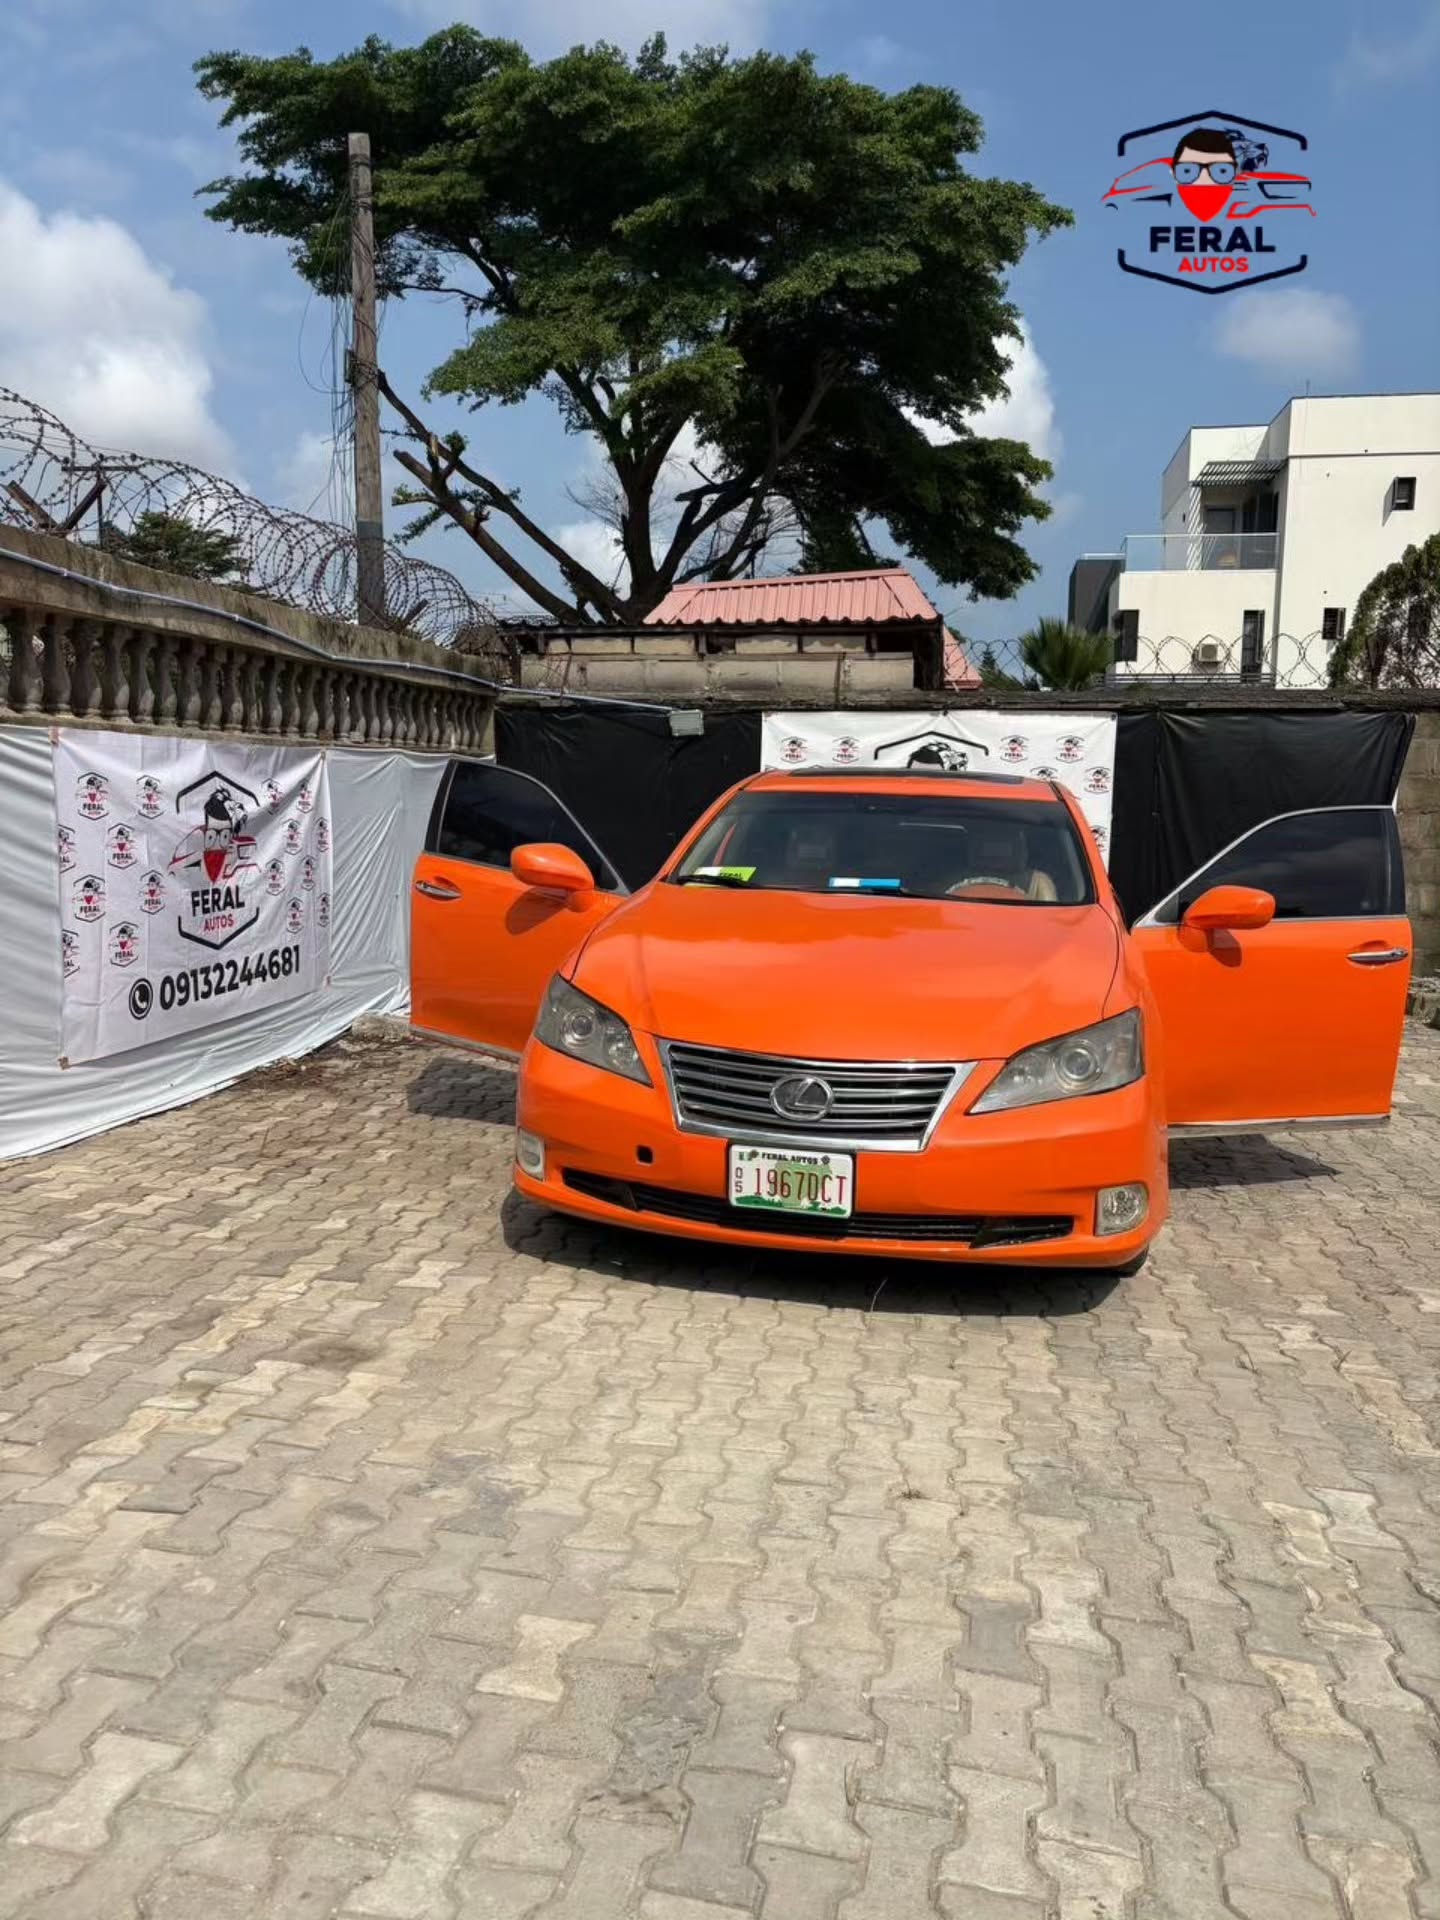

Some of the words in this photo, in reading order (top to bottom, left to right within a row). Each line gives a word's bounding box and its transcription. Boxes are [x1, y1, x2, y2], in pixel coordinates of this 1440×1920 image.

[82, 803, 105, 811] FERAL
[112, 852, 133, 860] FERAL
[191, 885, 246, 917] FERAL
[79, 905, 101, 914] FERAL
[203, 913, 235, 932] AUTOS
[115, 950, 134, 960] FERAL
[159, 944, 301, 1011] 09132244681
[761, 1152, 788, 1161] FERAL
[791, 1155, 819, 1165] AUTOS
